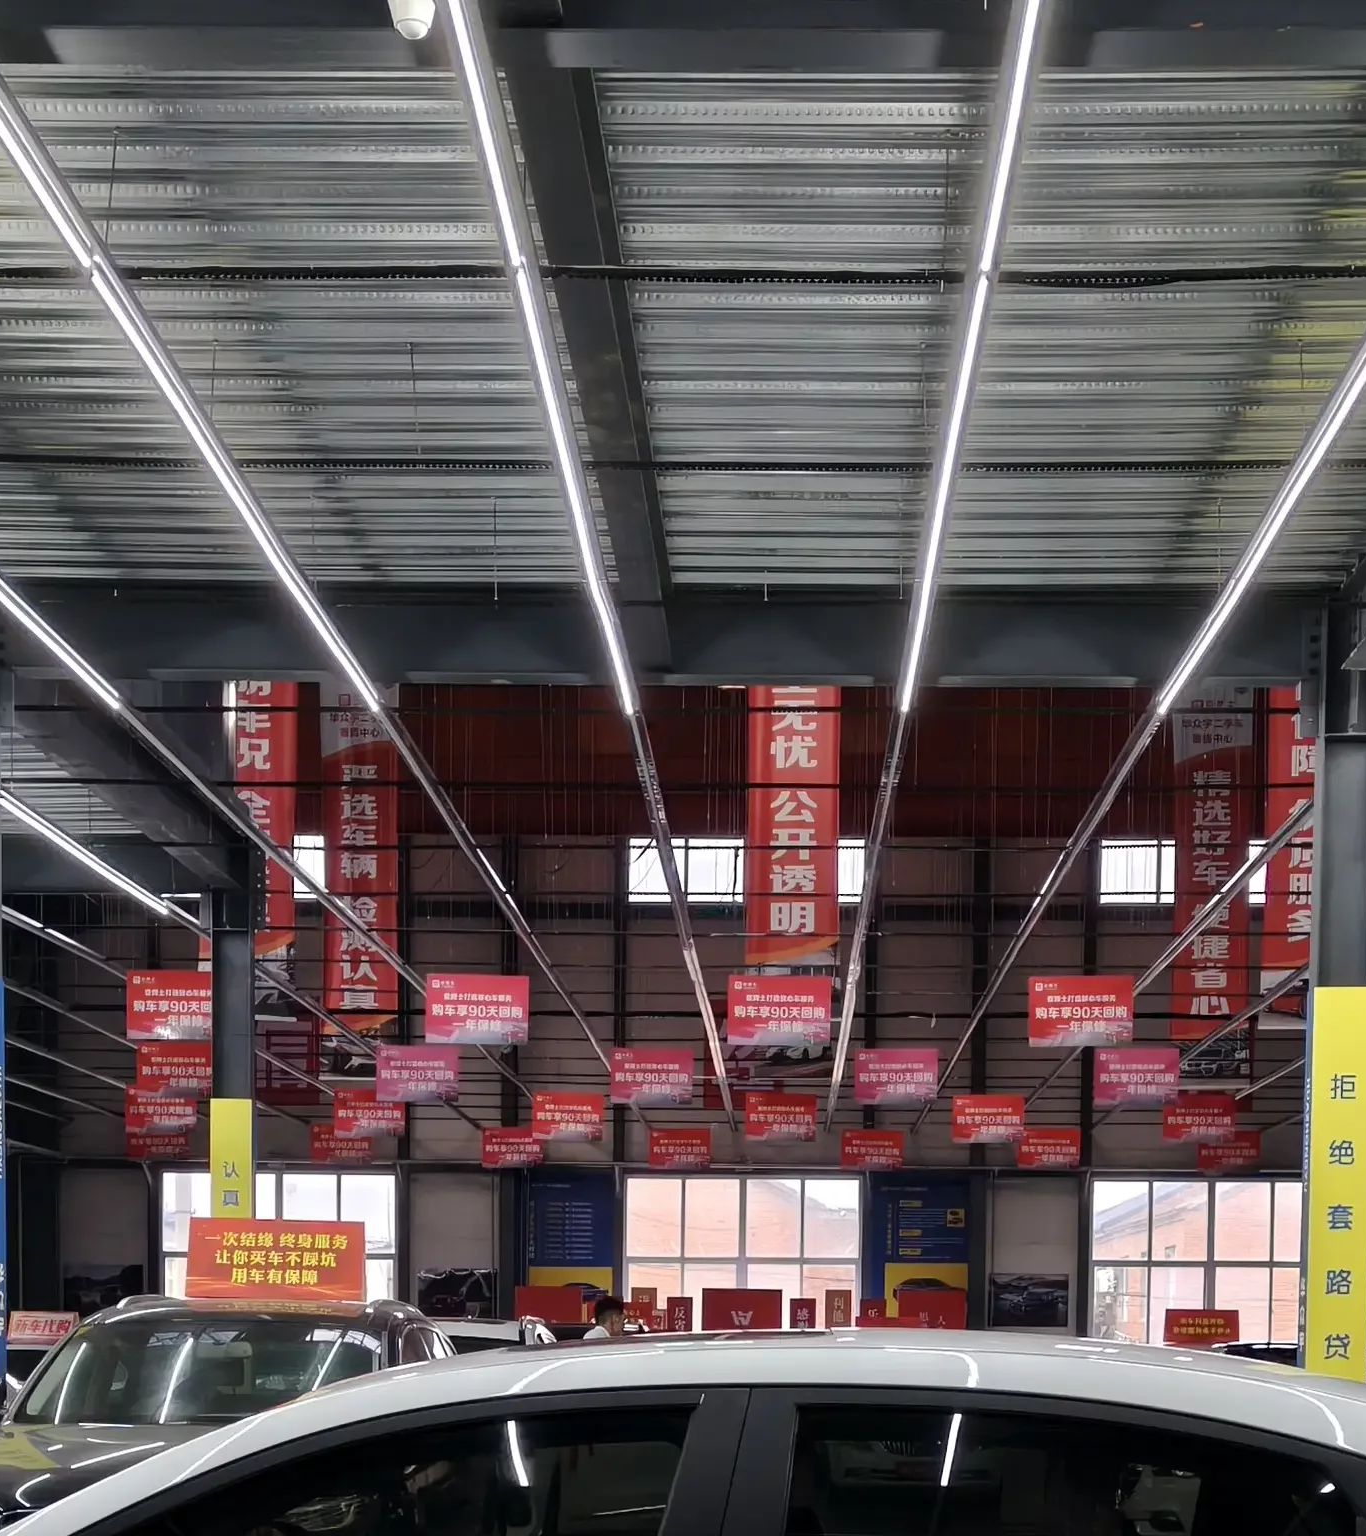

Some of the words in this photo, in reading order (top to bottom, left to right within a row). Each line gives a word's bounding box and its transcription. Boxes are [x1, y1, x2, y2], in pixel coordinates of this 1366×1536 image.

[1191, 770, 1232, 886] 精选好车
[769, 790, 818, 934] 公开透明
[133, 1000, 212, 1013] 购车享90天回
[431, 1003, 523, 1019] 购车享90天回购
[734, 1005, 826, 1019] 购车享90天回购
[1034, 1005, 1128, 1019] 购车享90天回购
[380, 1069, 455, 1081] 购车享90天回购
[614, 1072, 689, 1084] 购车享90天回购
[858, 1071, 934, 1083] 购车享90天回购
[1099, 1072, 1175, 1084] 购车享90天回购
[223, 1161, 240, 1207] 认真
[1324, 1073, 1357, 1361] 拒绝套路贷
[204, 1231, 274, 1248] 一次结缘
[279, 1233, 349, 1251] 终身服务
[215, 1249, 337, 1268] 让你买车不踩坑
[231, 1268, 319, 1286] 用车有保障
[14, 1318, 73, 1335] 新车代购
